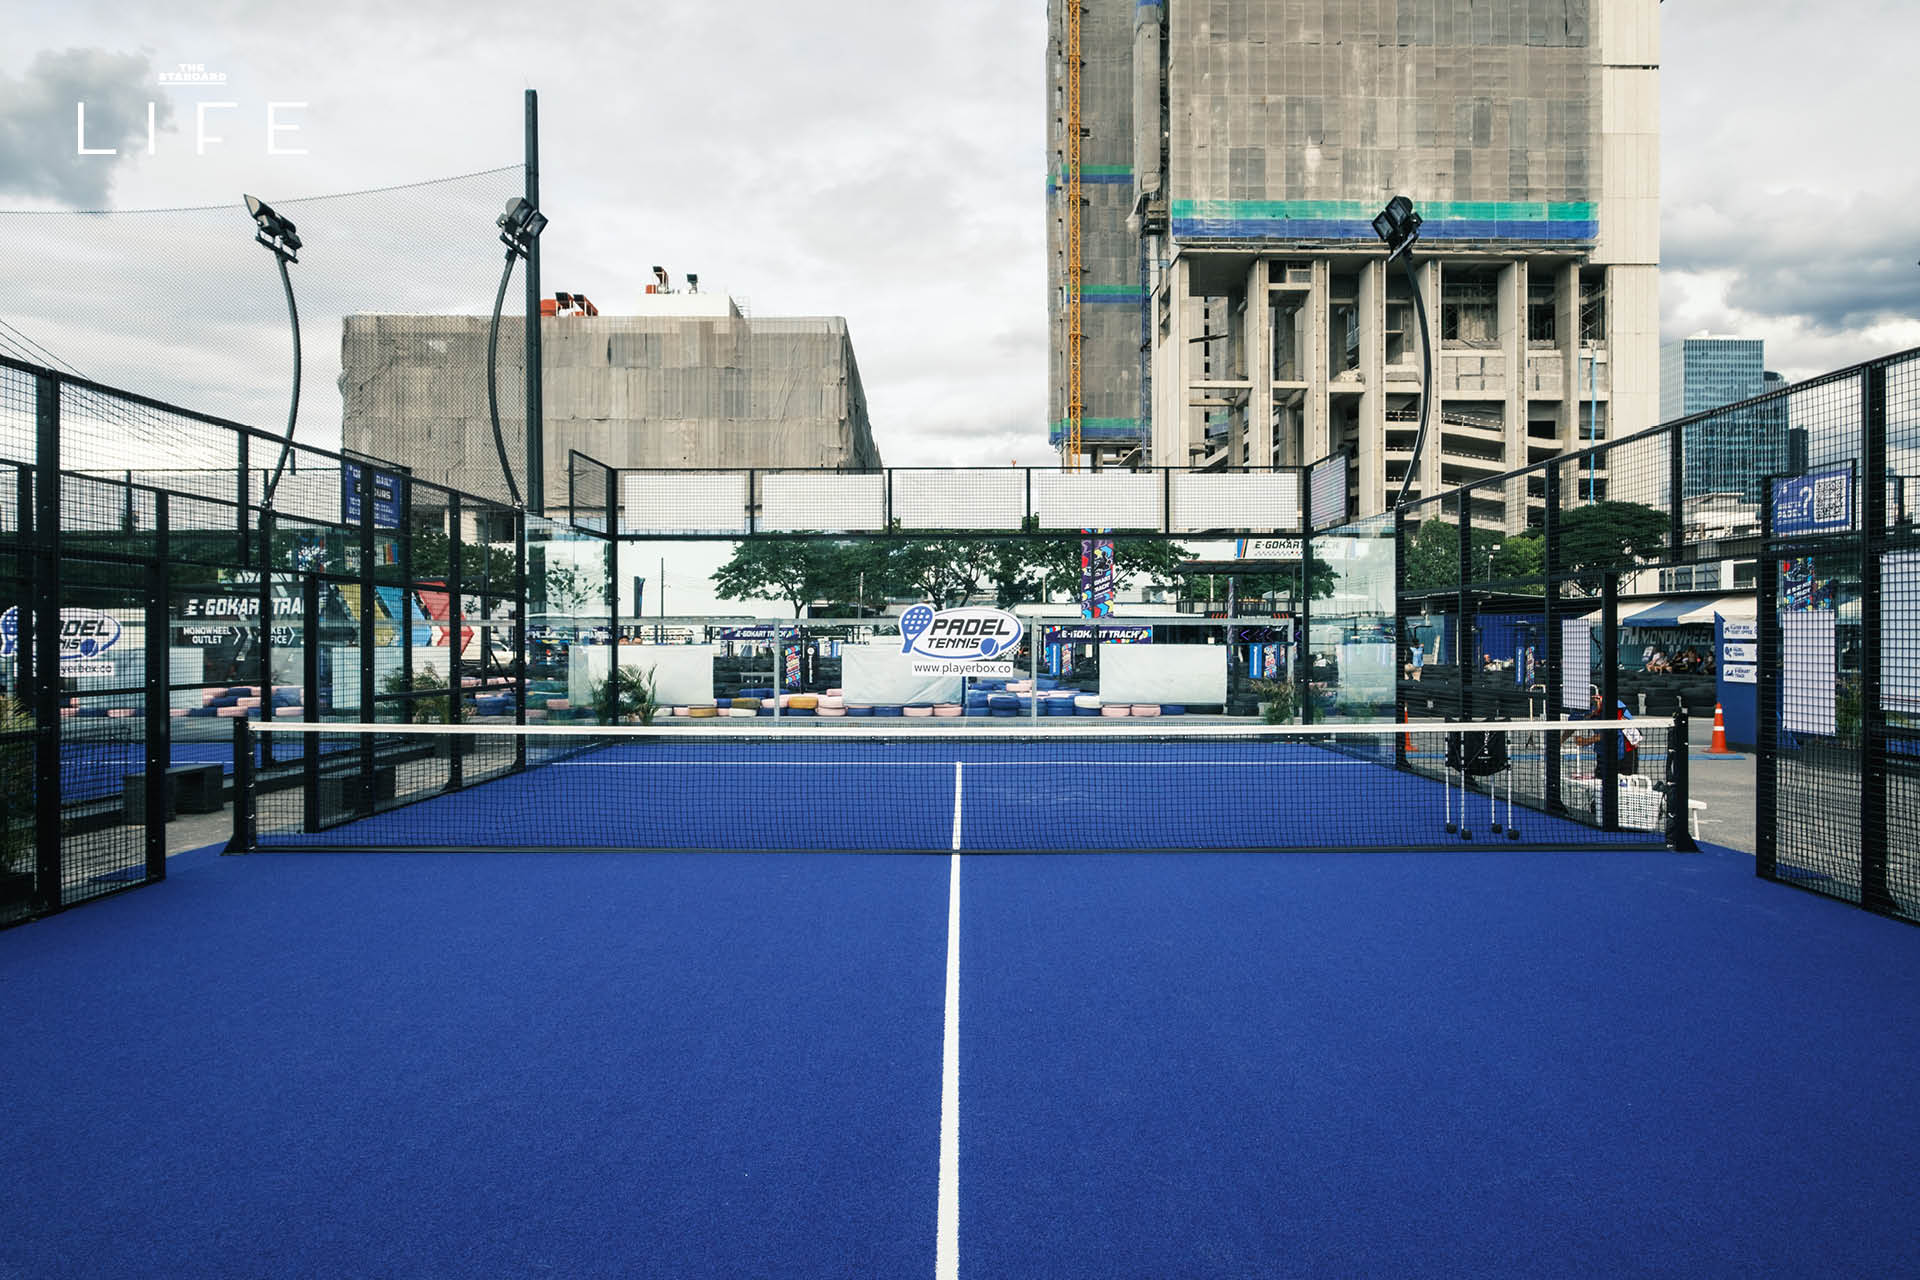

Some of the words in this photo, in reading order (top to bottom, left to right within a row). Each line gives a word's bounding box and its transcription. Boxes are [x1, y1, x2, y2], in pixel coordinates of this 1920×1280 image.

[184, 597, 261, 616] E-GOKAR
[183, 626, 232, 635] MONOWHEEL
[929, 618, 1011, 636] PADEL
[192, 635, 223, 644] OUTLET
[927, 637, 982, 649] TENNIS
[913, 661, 1012, 675] www.playerbox.co
